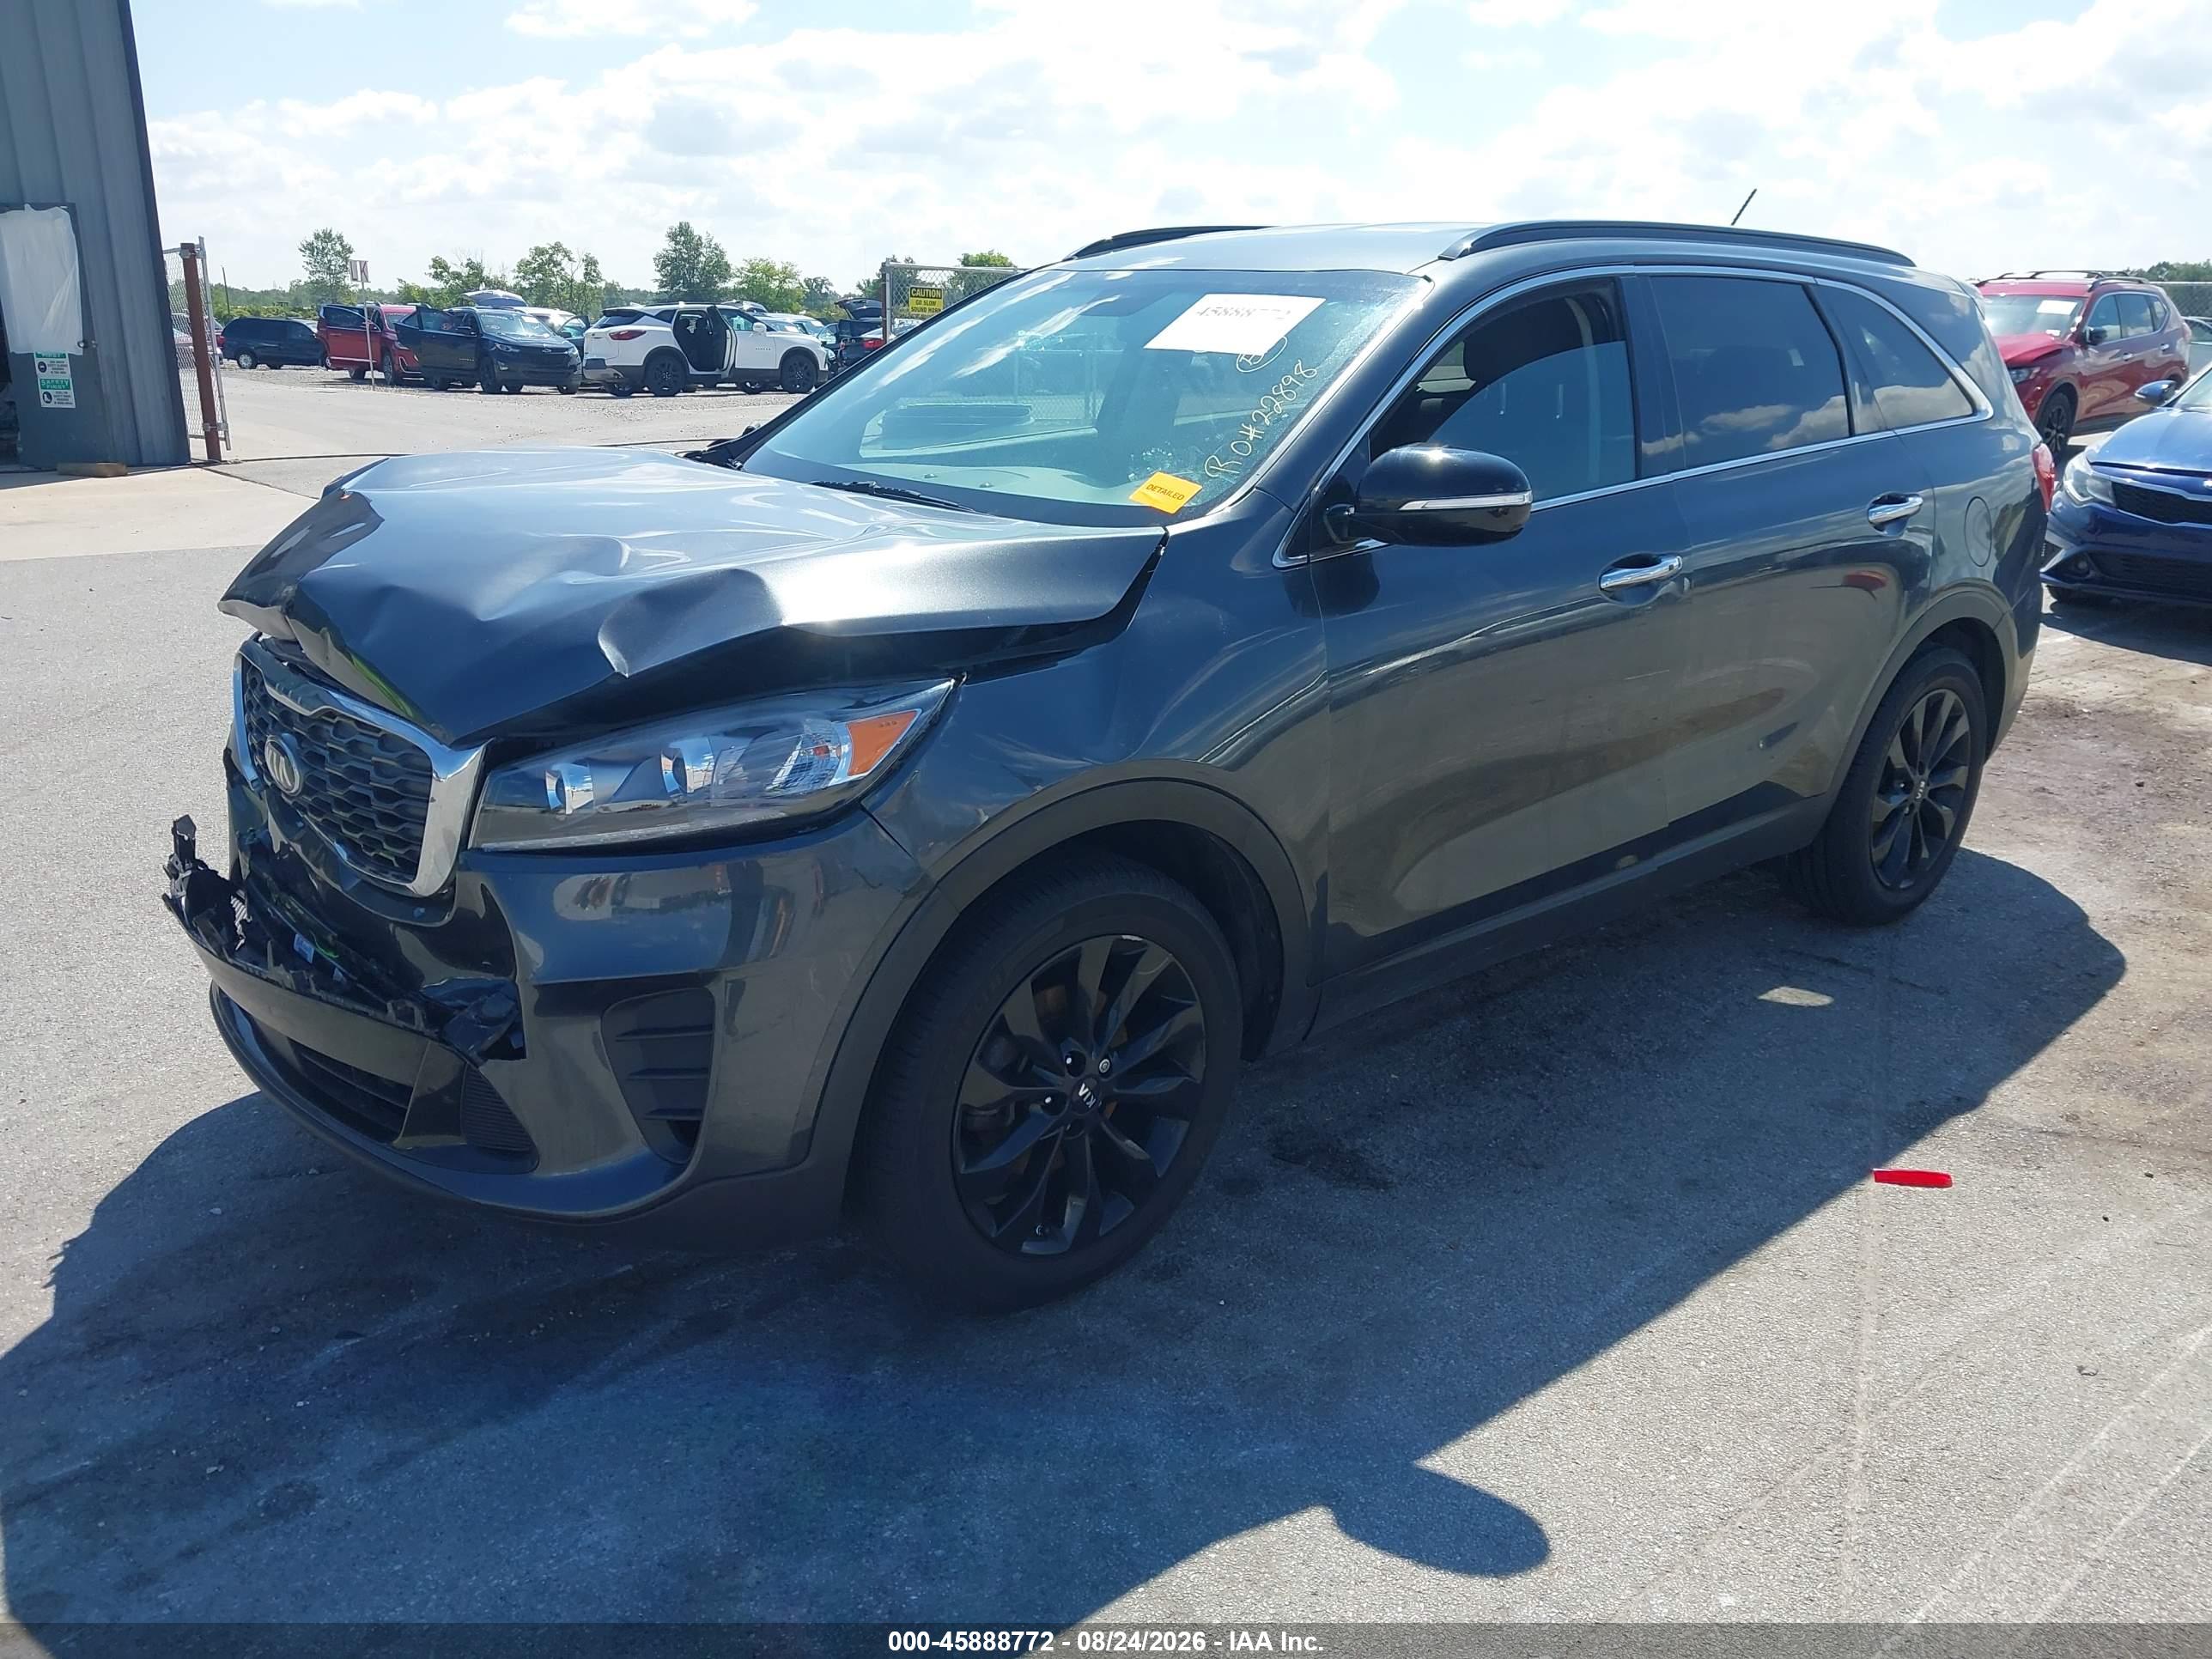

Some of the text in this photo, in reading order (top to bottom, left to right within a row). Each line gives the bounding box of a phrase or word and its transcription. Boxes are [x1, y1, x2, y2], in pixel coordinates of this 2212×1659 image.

[911, 288, 941, 299] CAUTION
[1145, 483, 1185, 501] DETAILED
[1078, 1082, 1097, 1109] KIA
